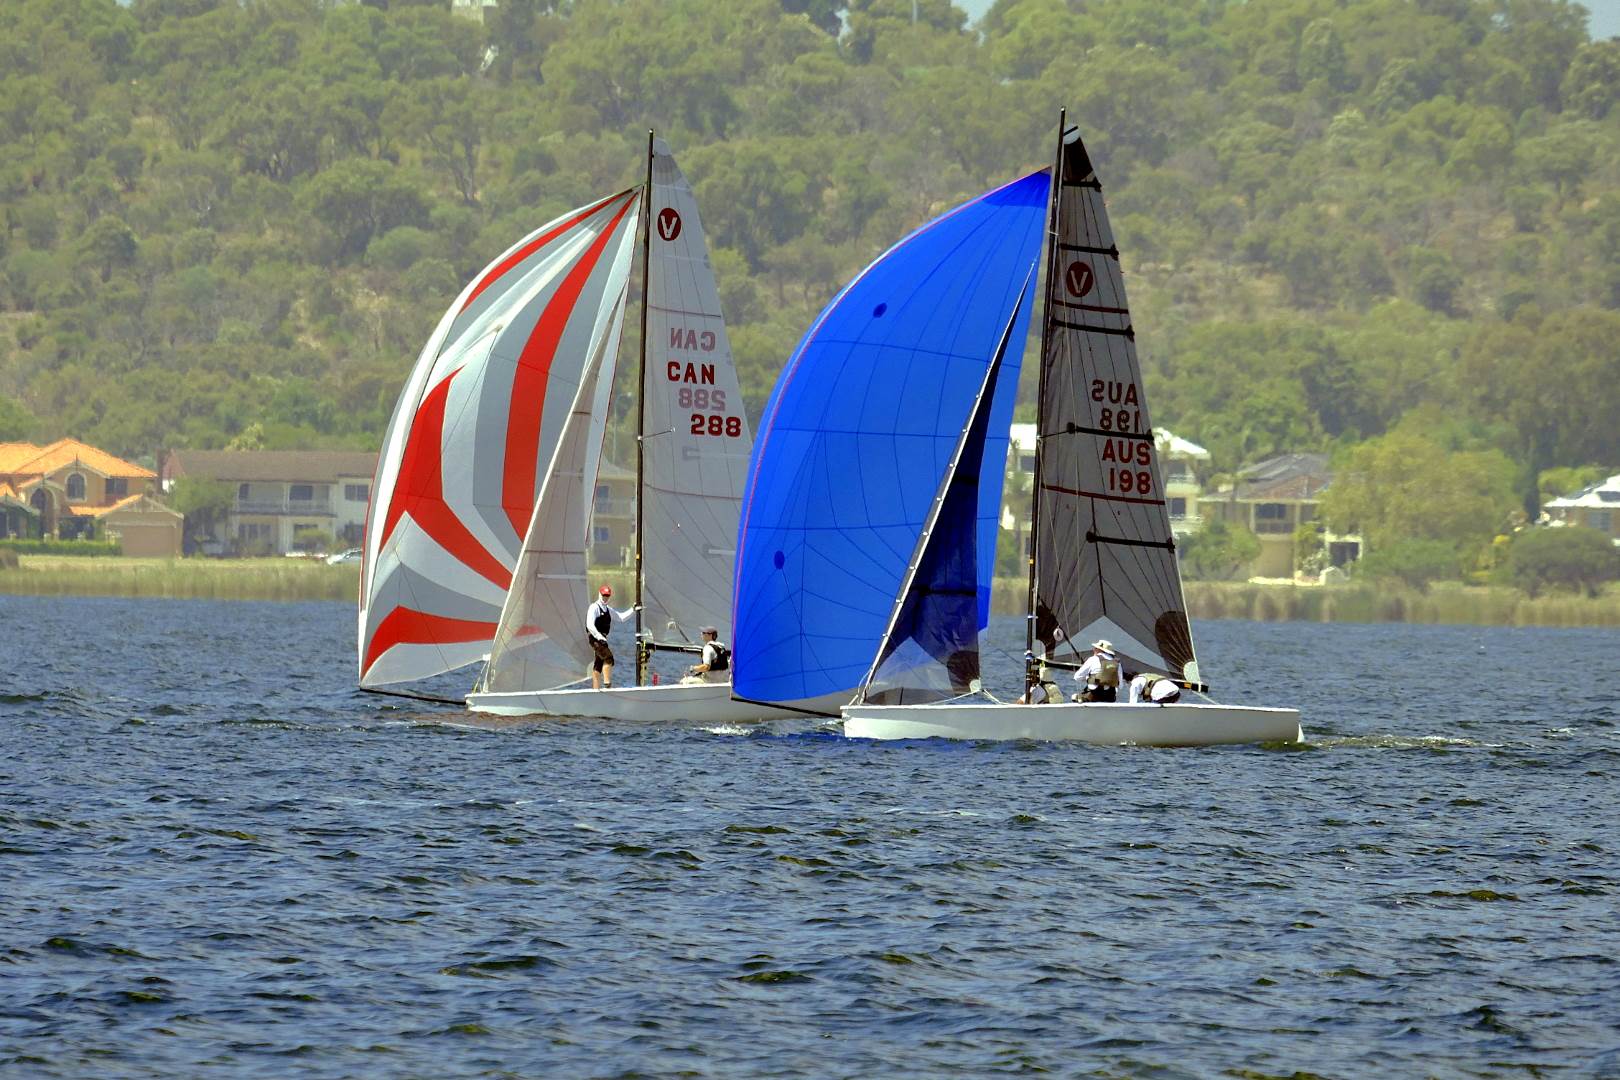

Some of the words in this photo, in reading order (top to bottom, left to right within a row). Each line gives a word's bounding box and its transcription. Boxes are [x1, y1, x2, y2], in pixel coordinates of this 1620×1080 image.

[667, 361, 715, 385] CAN
[690, 414, 742, 438] 288
[1102, 439, 1151, 466] AUS
[1109, 467, 1151, 495] 198
